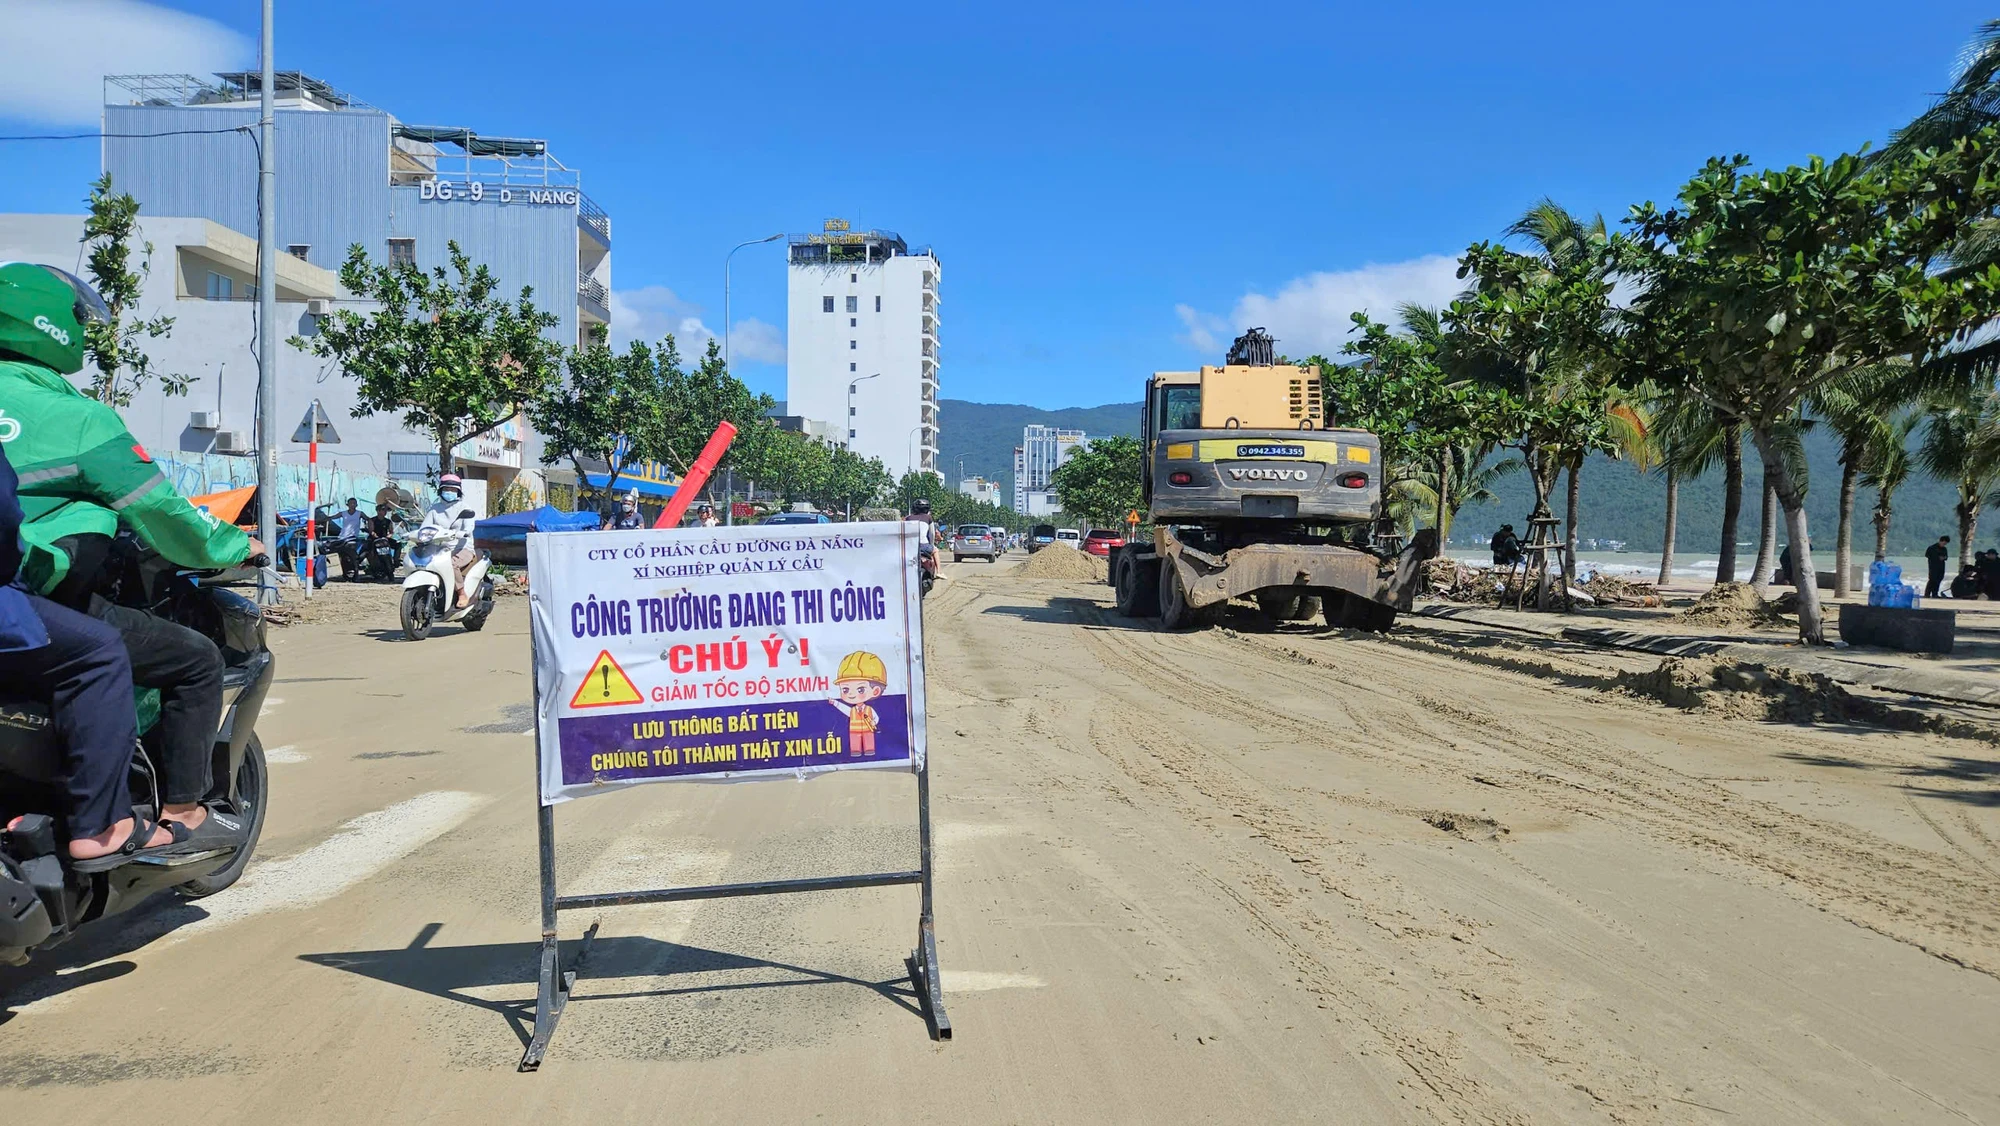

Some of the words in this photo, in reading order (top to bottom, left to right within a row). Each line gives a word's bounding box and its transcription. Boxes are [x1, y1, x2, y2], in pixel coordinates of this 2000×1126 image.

[529, 190, 576, 205] NANG
[34, 315, 70, 346] Grab
[478, 444, 501, 460] DANANG
[1248, 447, 1303, 456] 0942.345.355
[1228, 468, 1308, 481] VOLVO
[588, 549, 618, 560] CTY
[624, 542, 645, 558] CỔ
[650, 540, 694, 557] PHẦN
[699, 538, 731, 555] CẦU
[736, 539, 790, 553] ĐƯỜNG
[796, 537, 816, 551] ĐÀ
[821, 534, 864, 550] NẴNG
[633, 564, 649, 578] XÍ
[654, 561, 715, 577] NGHIỆP
[720, 557, 763, 575] QUẢN
[768, 557, 786, 571] LÝ
[792, 554, 824, 570] CẦU
[571, 594, 632, 638] CÔNG
[637, 588, 723, 634] TRƯỜNG
[728, 590, 786, 628] ĐANG
[791, 589, 824, 624] THI
[830, 580, 886, 622] CÔNG
[669, 635, 748, 674] CHÚ
[760, 633, 784, 668] Ý
[799, 638, 810, 666] !
[652, 679, 697, 702] GIẢM
[703, 676, 739, 699] TỐC
[745, 676, 771, 698] ĐỘ
[776, 676, 829, 694] 5KM/H
[633, 720, 665, 740] LƯU
[669, 715, 724, 737] THÔNG
[728, 708, 758, 733] BẤT
[763, 708, 799, 733] TIỆN
[591, 749, 648, 772] CHÚNG
[652, 746, 678, 766] TÔI
[683, 742, 737, 764] THÀNH
[741, 738, 780, 762] THẬT
[784, 739, 813, 757] XIN
[817, 732, 842, 755] LỖI
